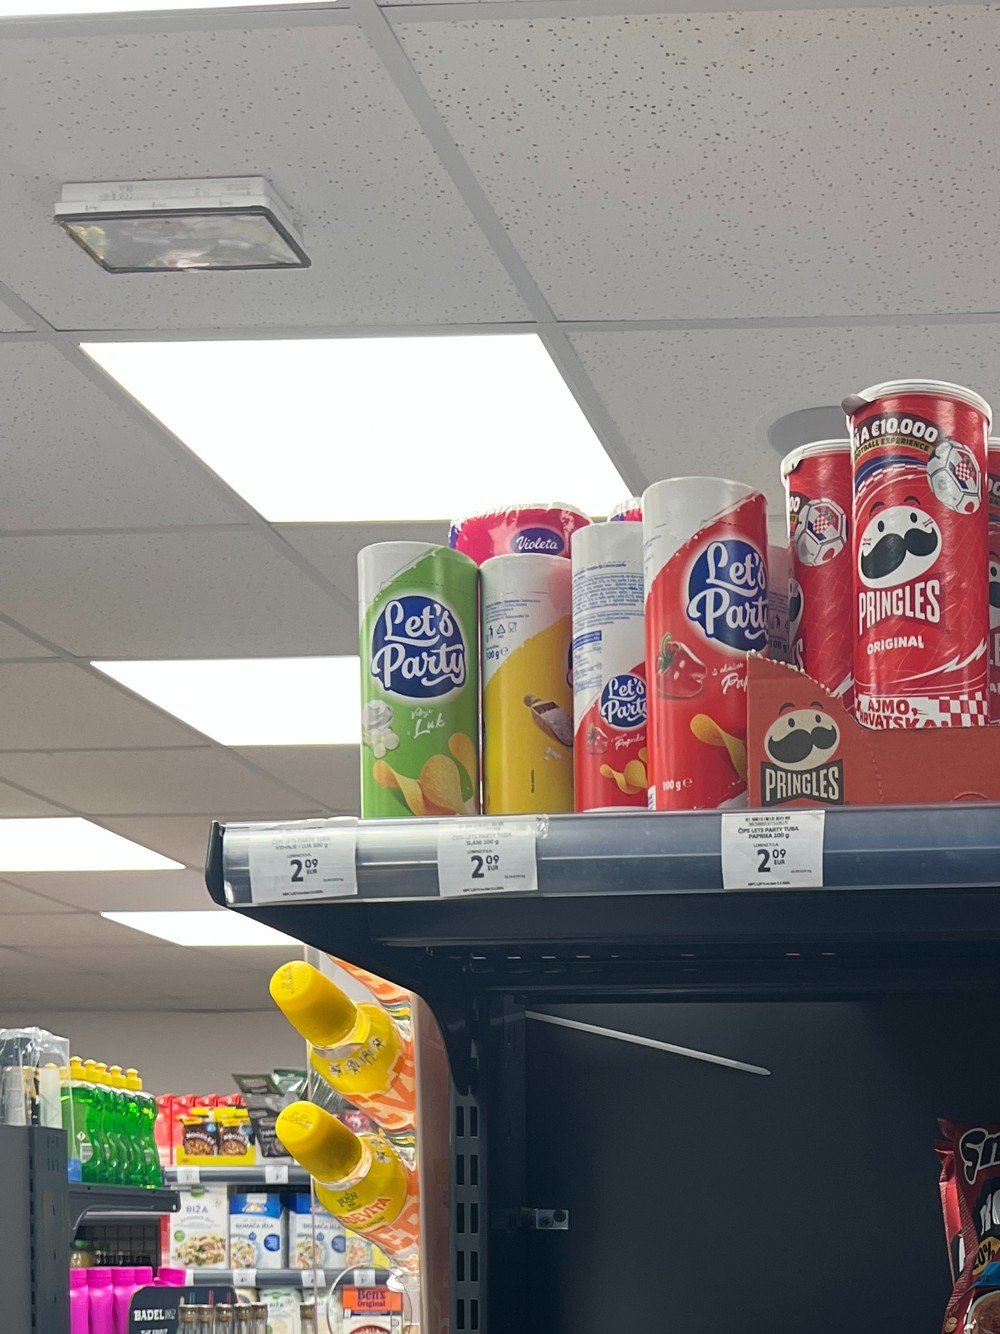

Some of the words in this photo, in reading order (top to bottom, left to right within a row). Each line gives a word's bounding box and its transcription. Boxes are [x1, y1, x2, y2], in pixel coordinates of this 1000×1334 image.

[870, 417, 939, 443] €10.000
[516, 535, 559, 551] Violeta
[858, 579, 941, 636] PRINGLES
[383, 599, 455, 647] Let's
[866, 635, 924, 654] ORIGINAL
[371, 644, 467, 690] Party
[607, 677, 645, 702] Let's
[764, 765, 840, 802] PRINGLES
[290, 859, 304, 882] 2
[304, 859, 318, 868] 09
[470, 855, 484, 878] 2
[486, 855, 500, 864] 09
[757, 849, 771, 873] 2
[772, 849, 786, 859] 09
[356, 1299, 386, 1308] Original
[357, 1288, 386, 1300] Ben's
